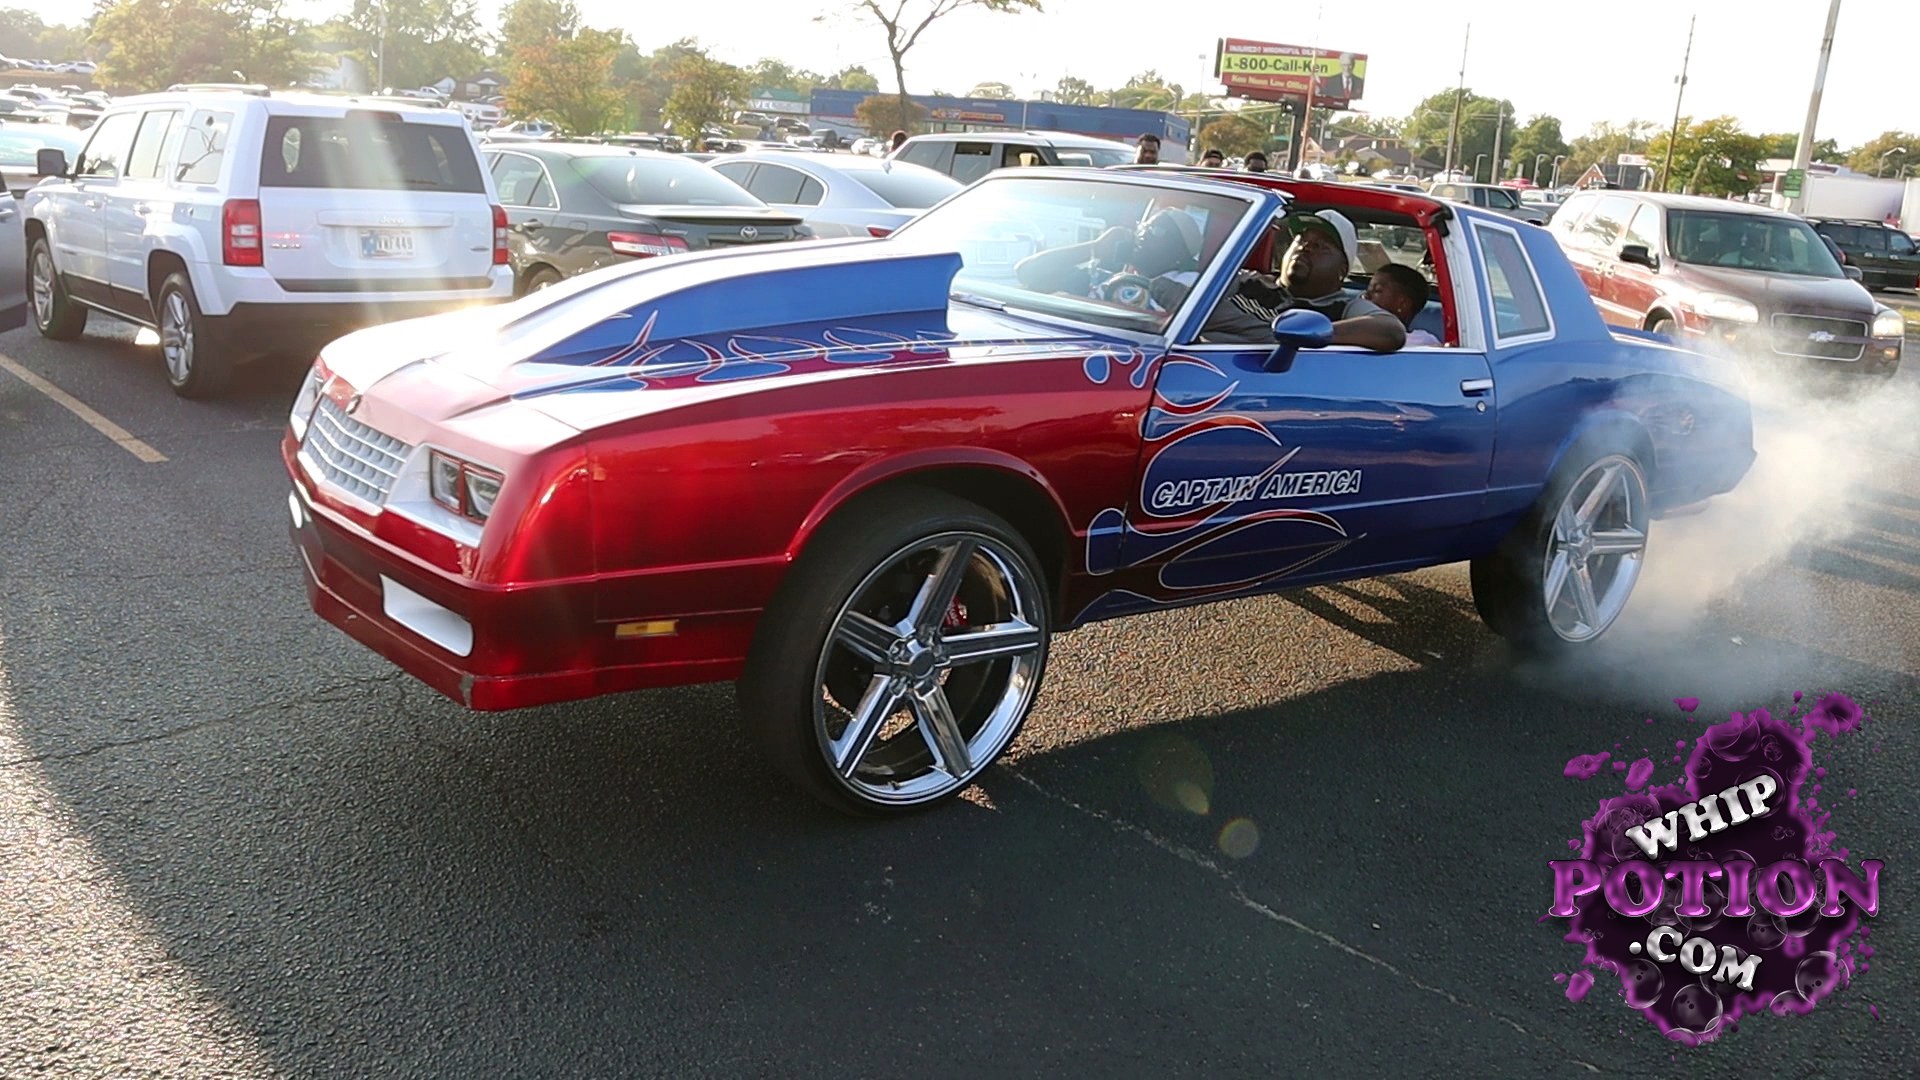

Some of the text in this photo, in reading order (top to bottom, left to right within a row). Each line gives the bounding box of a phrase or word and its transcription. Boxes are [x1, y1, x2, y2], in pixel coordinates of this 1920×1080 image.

[1224, 56, 1329, 74] 1-800-Call-Ken
[1151, 470, 1363, 509] CAPTAIN AMERICA
